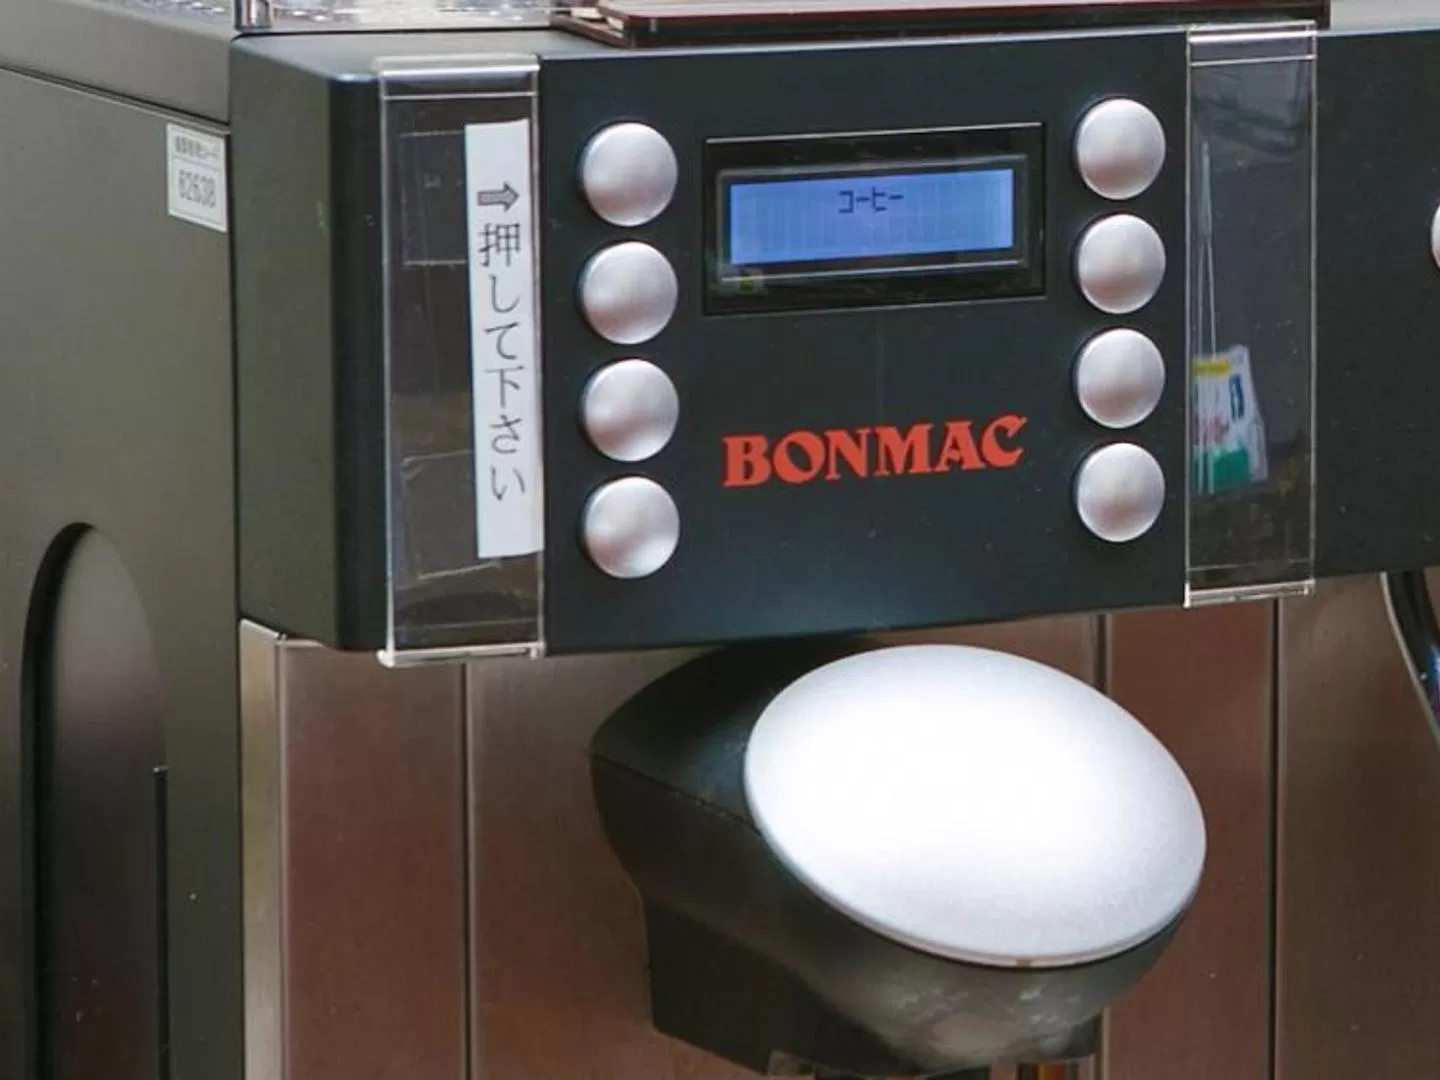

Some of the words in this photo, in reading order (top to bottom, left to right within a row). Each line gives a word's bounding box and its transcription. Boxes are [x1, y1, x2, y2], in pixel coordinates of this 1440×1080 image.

[838, 186, 904, 213] コーヒー
[478, 219, 526, 501] 押して下さい
[722, 414, 1027, 488] BONMAC
